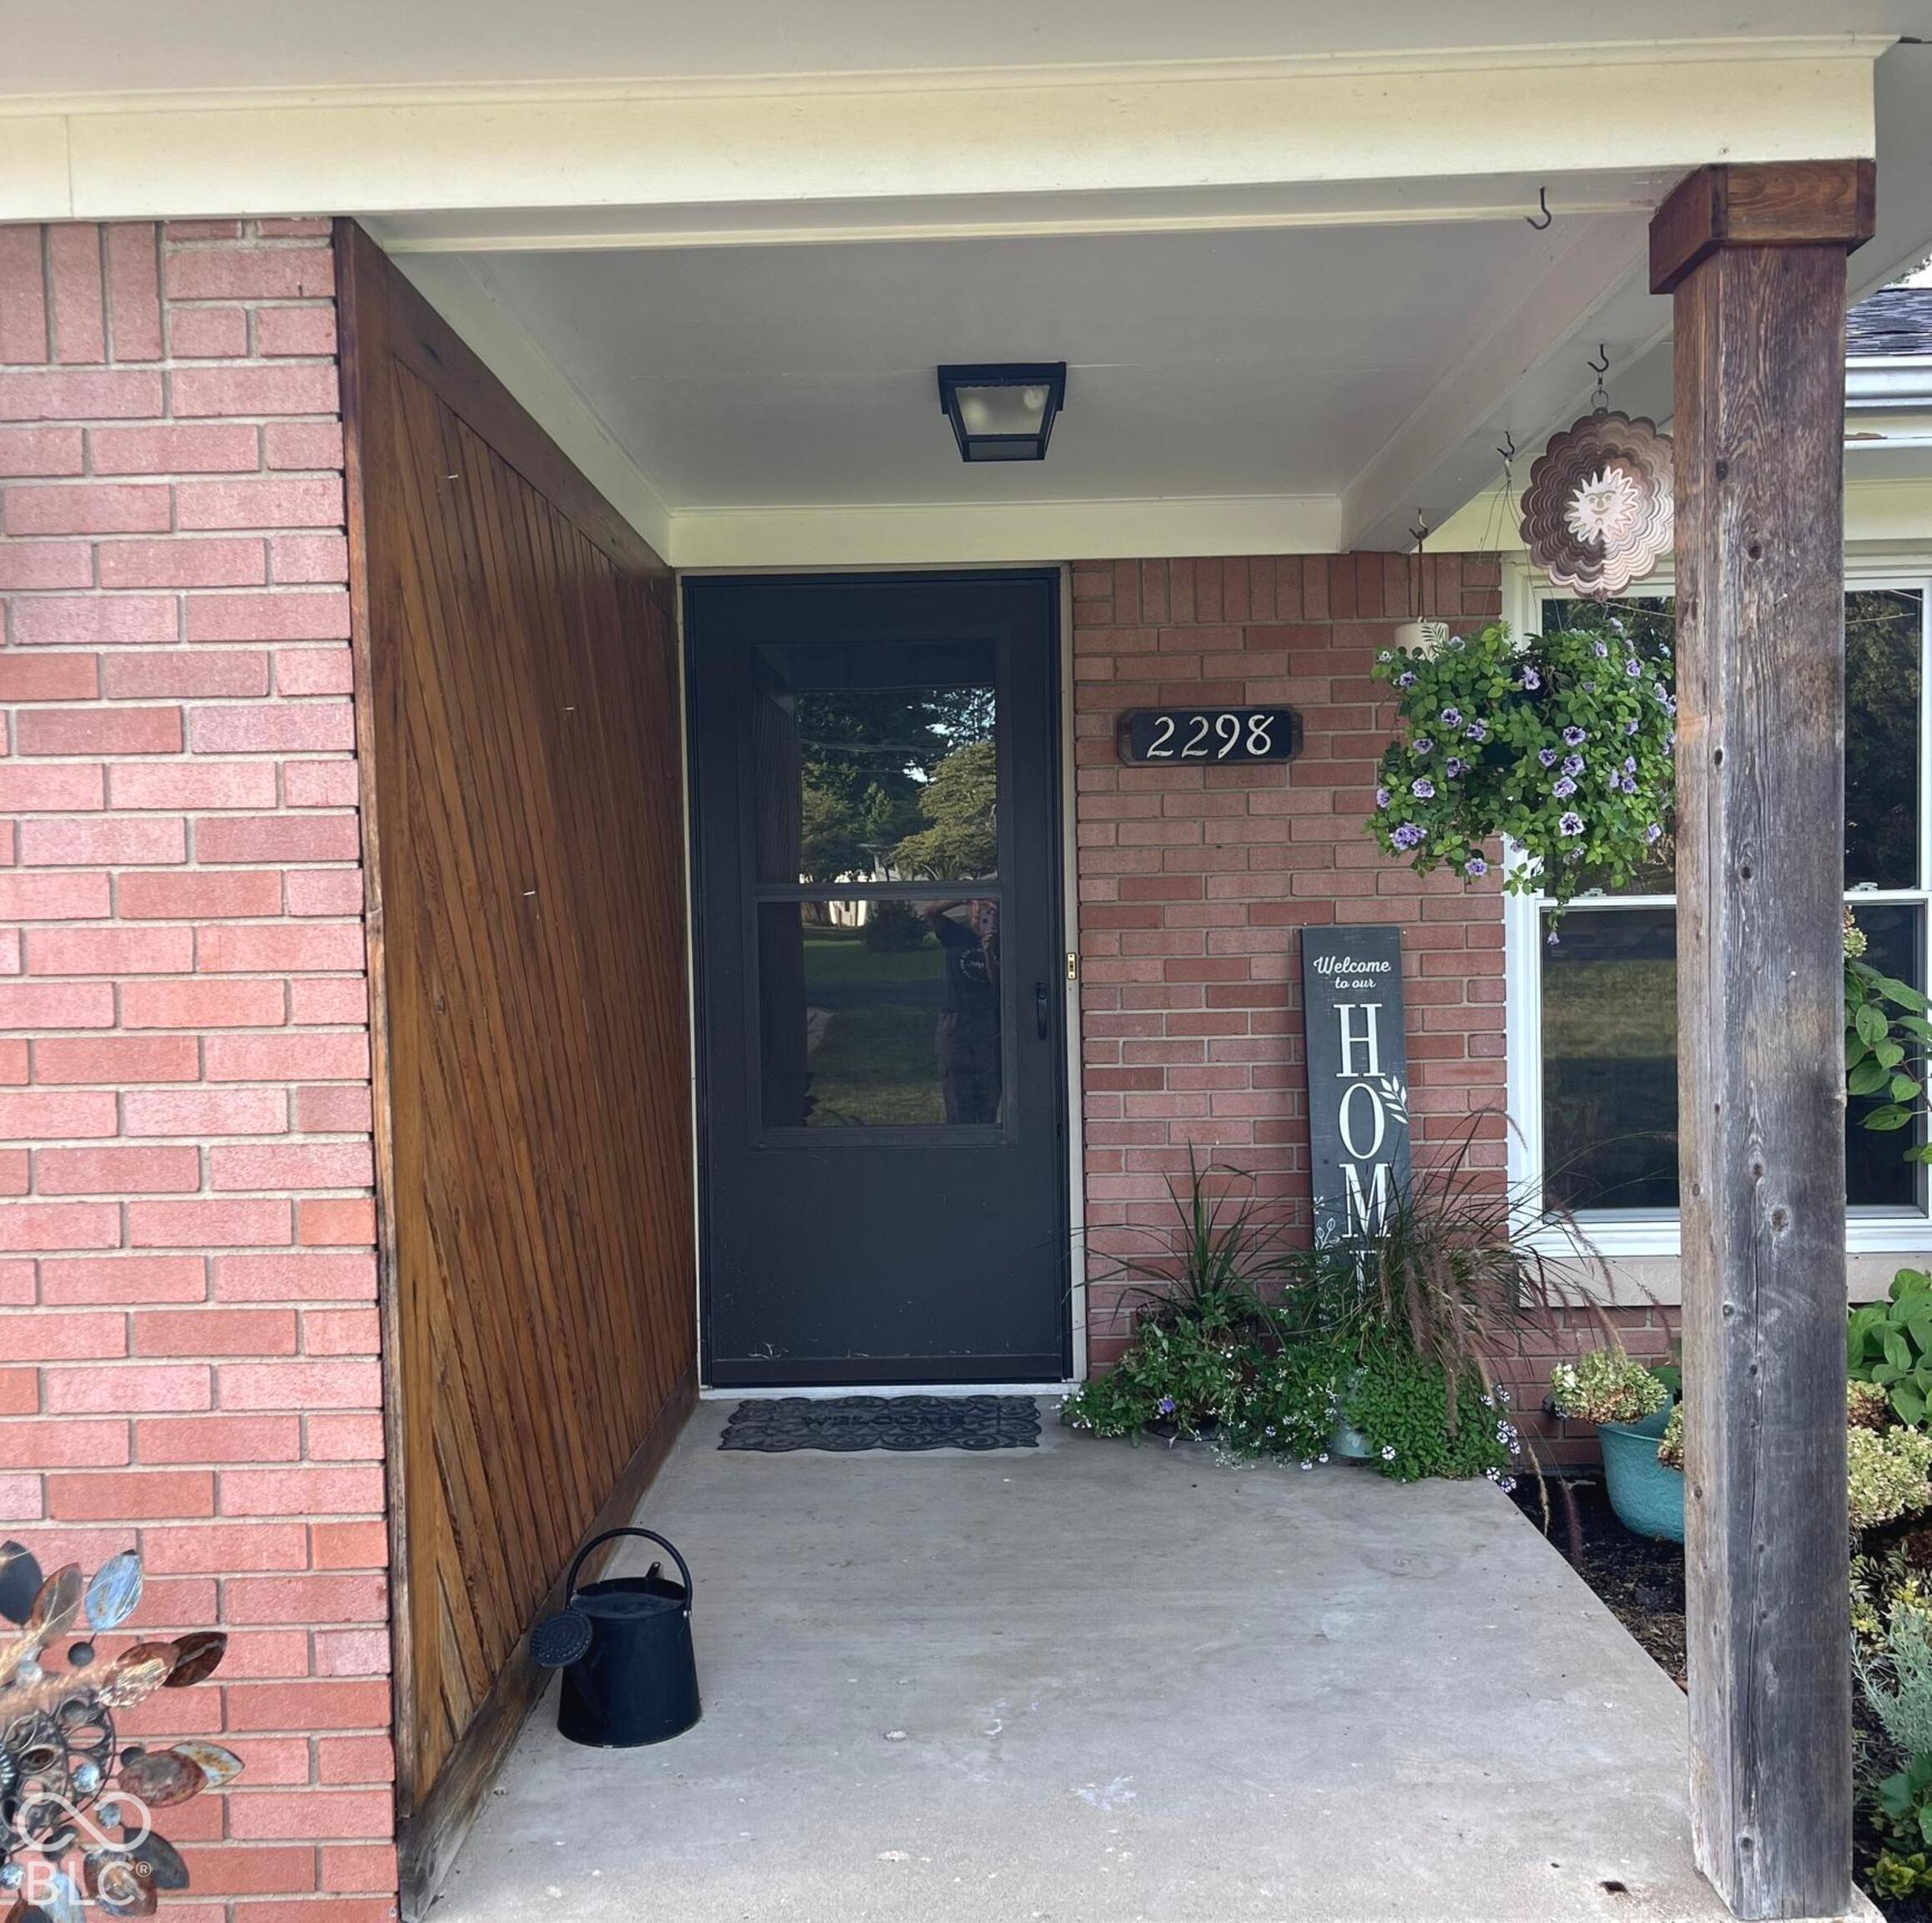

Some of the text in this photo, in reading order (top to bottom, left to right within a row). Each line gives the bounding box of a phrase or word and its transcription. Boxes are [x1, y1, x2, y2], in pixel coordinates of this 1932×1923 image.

[1146, 714, 1275, 760] 2298
[1313, 956, 1392, 975] Welcome
[1334, 977, 1378, 989] to our
[802, 1414, 966, 1426] WELCOME
